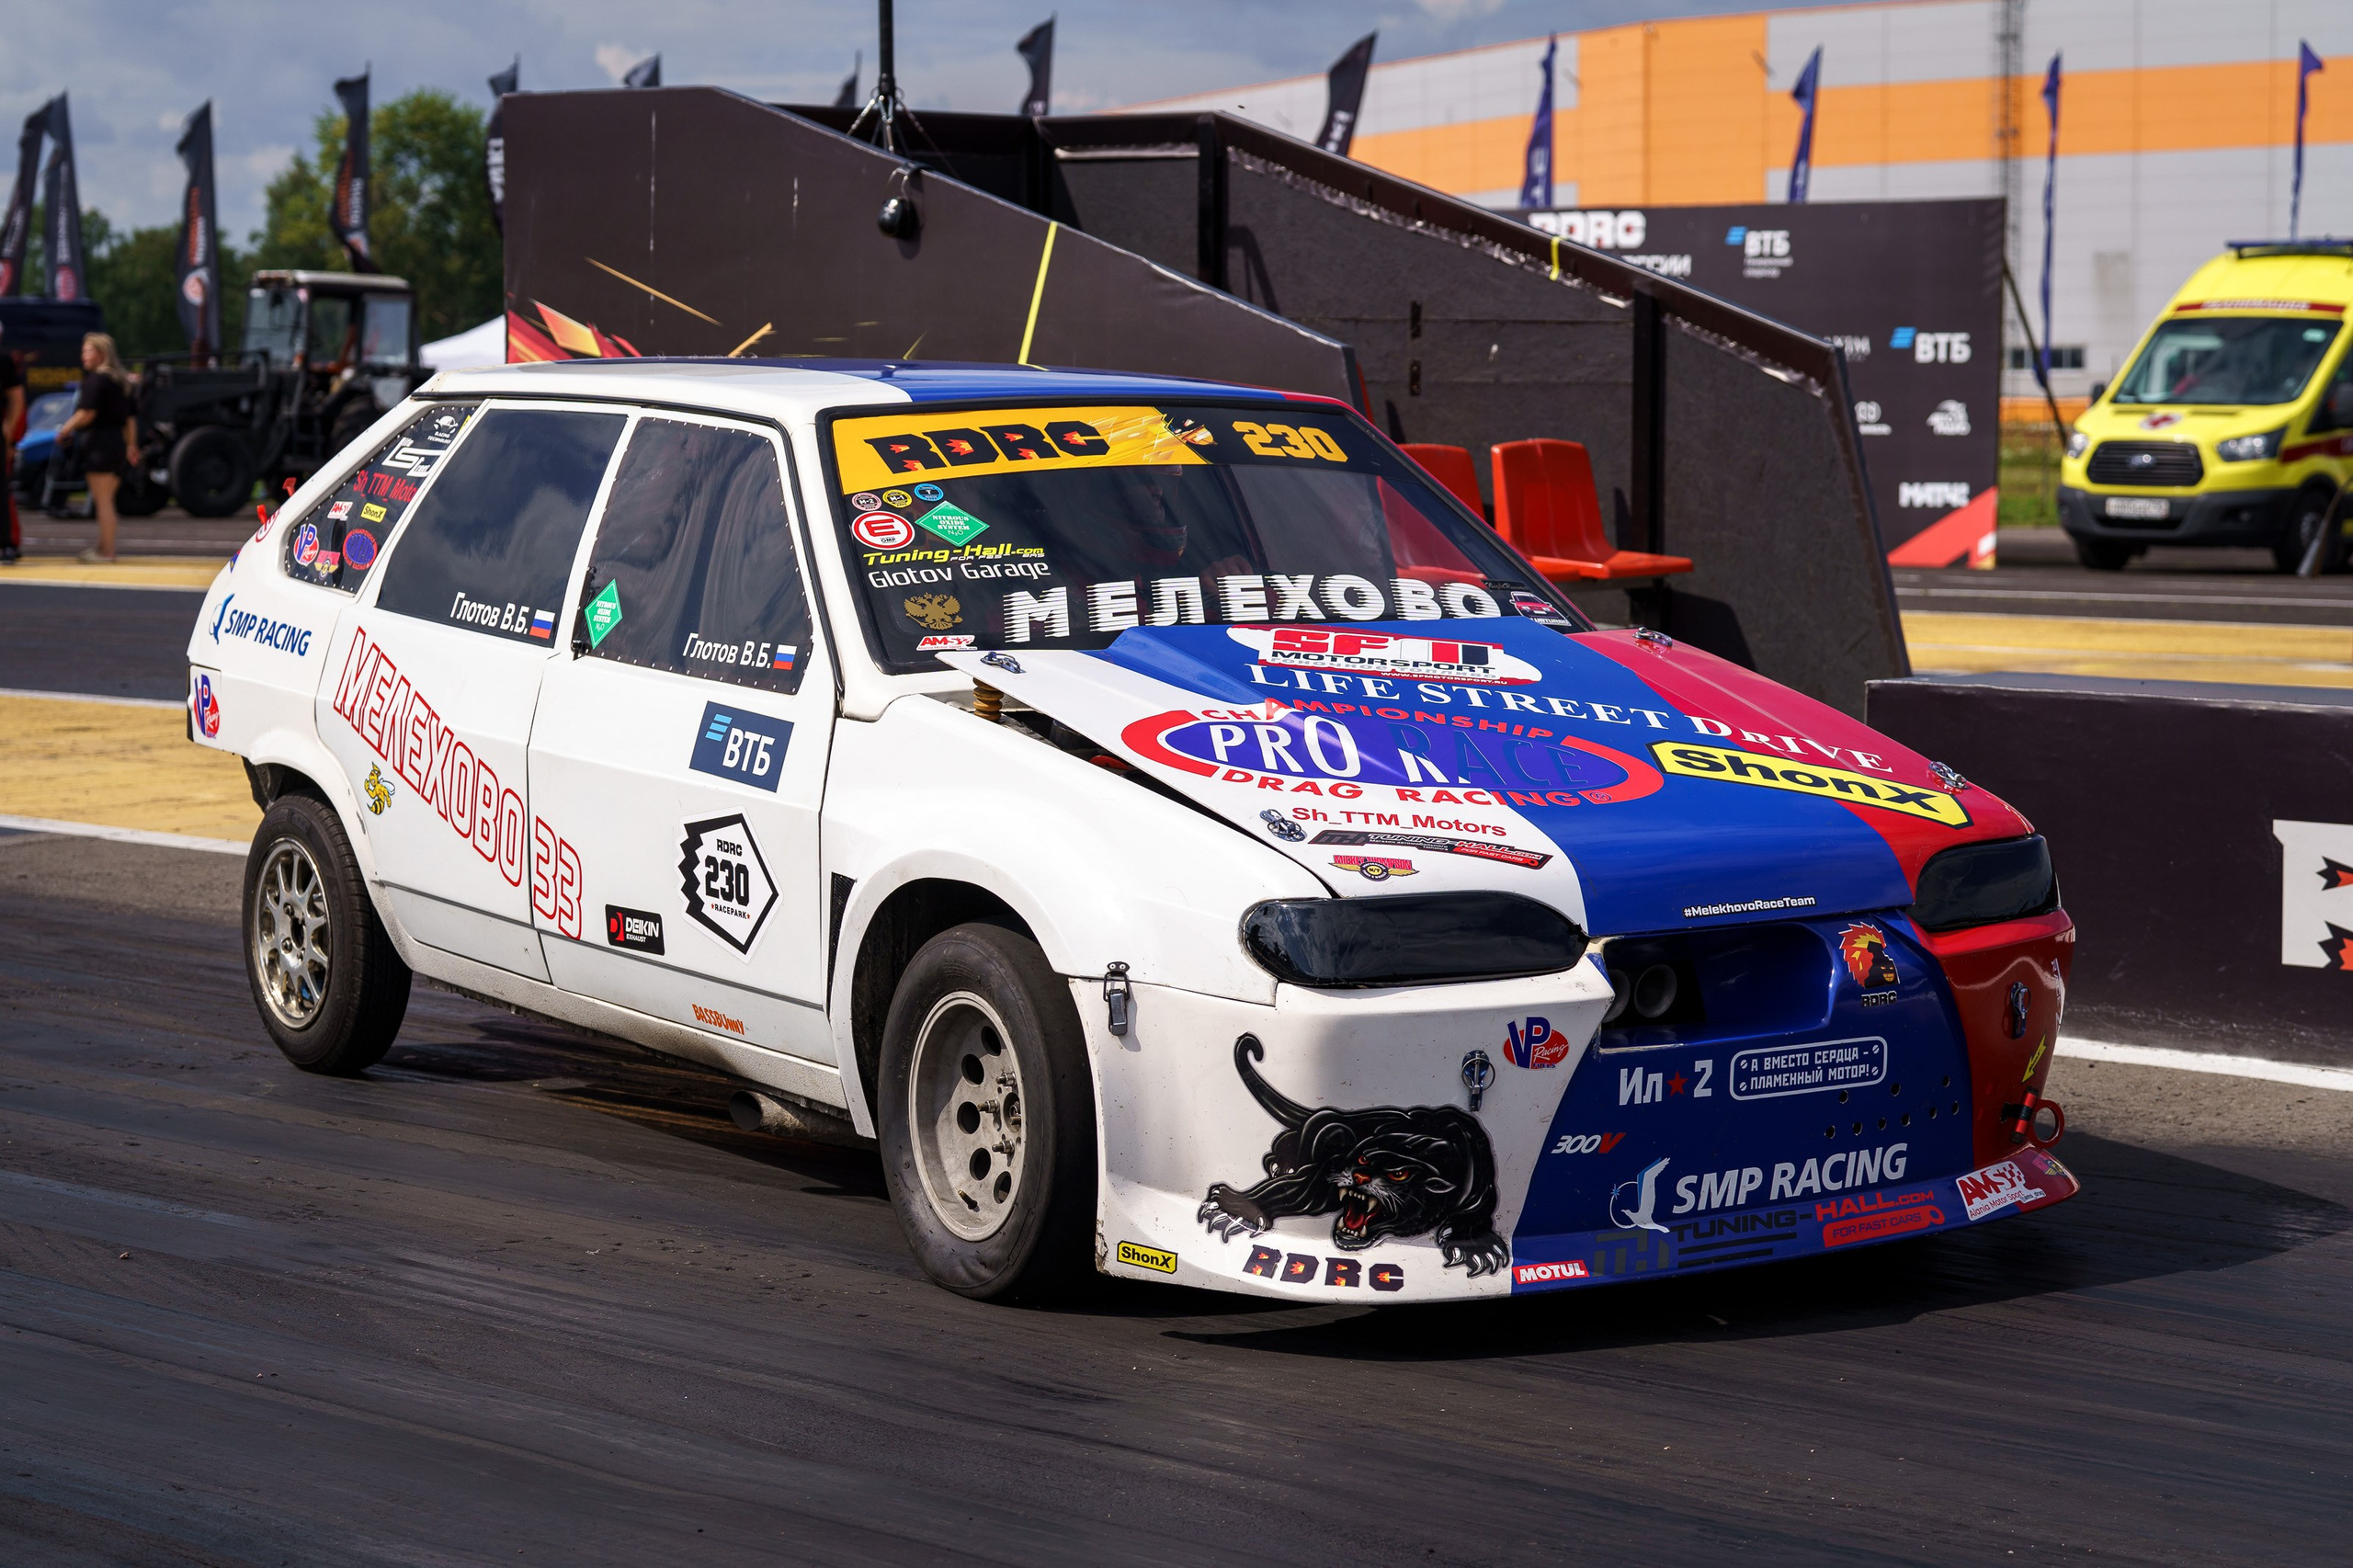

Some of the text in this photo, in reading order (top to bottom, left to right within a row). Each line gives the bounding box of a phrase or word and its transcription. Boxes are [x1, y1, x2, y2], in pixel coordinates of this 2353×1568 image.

[1745, 230, 1790, 257] ВТБ
[1915, 332, 1972, 363] ВТБ
[863, 421, 1110, 474] RDRC
[1232, 421, 1348, 462] 230
[364, 506, 383, 519] ShonX
[864, 518, 901, 538] E
[296, 523, 317, 562] VP
[863, 543, 1044, 566] Tuning-Hall.com
[868, 562, 1051, 588] Glotov Garage
[449, 591, 530, 635] Глотов В.Б.
[1003, 574, 1502, 643] МЕЛЕХОВО
[224, 609, 313, 657] SMP RACING
[682, 632, 772, 669] Глотов В.Б.
[1271, 651, 1495, 674] MOTORSPORT
[1381, 672, 1507, 685] WWW.SFMOTORSPORT.RU
[194, 674, 211, 737] VP
[1199, 698, 1553, 740] CHAMPIONSHIP
[1244, 663, 1894, 774] LIFE STREET DRIVE
[205, 710, 221, 730] Racing
[722, 727, 776, 777] ВТБ
[1209, 714, 1590, 788] PRO RACE
[334, 625, 583, 940] МЕЛЕХОВО 33
[1222, 768, 1582, 808] DRAG RACING
[1292, 808, 1507, 836] Sh_TTM_Motors
[716, 838, 743, 857] RDRC
[1368, 833, 1544, 860] TUNING-HALL.COM
[1333, 855, 1413, 870] MICKEY THOMPSON
[704, 855, 750, 907] 230
[714, 903, 747, 919] RACEPARK
[1684, 896, 1816, 917] #MelekhovoRaceTeam
[625, 917, 660, 937] DEIKIN
[626, 934, 647, 943] EXHAUST
[1861, 991, 1897, 1008] RDRC
[1506, 1017, 1552, 1069] VP
[1533, 1043, 1569, 1063] Racing
[1751, 1057, 1759, 1072] А
[1764, 1052, 1809, 1070] ВМЕСТО
[1813, 1048, 1859, 1065] СЕРДЦА
[1619, 1059, 1713, 1106] Ил 2
[1750, 1063, 1870, 1090] ПЛАМЕННЫЙ МОТОР!
[1551, 1131, 1627, 1154] 300V
[1672, 1142, 1908, 1214] SMP RACING
[1671, 1189, 1935, 1243] TUNING-HALL.COM
[1969, 1202, 1991, 1219] Alania
[1989, 1196, 2008, 1210] Motor
[1832, 1211, 1922, 1239] FOR FAST CARS
[1120, 1245, 1173, 1271] ShonX
[1243, 1244, 1404, 1291] RDRC
[1520, 1262, 1586, 1283] MOTUL
